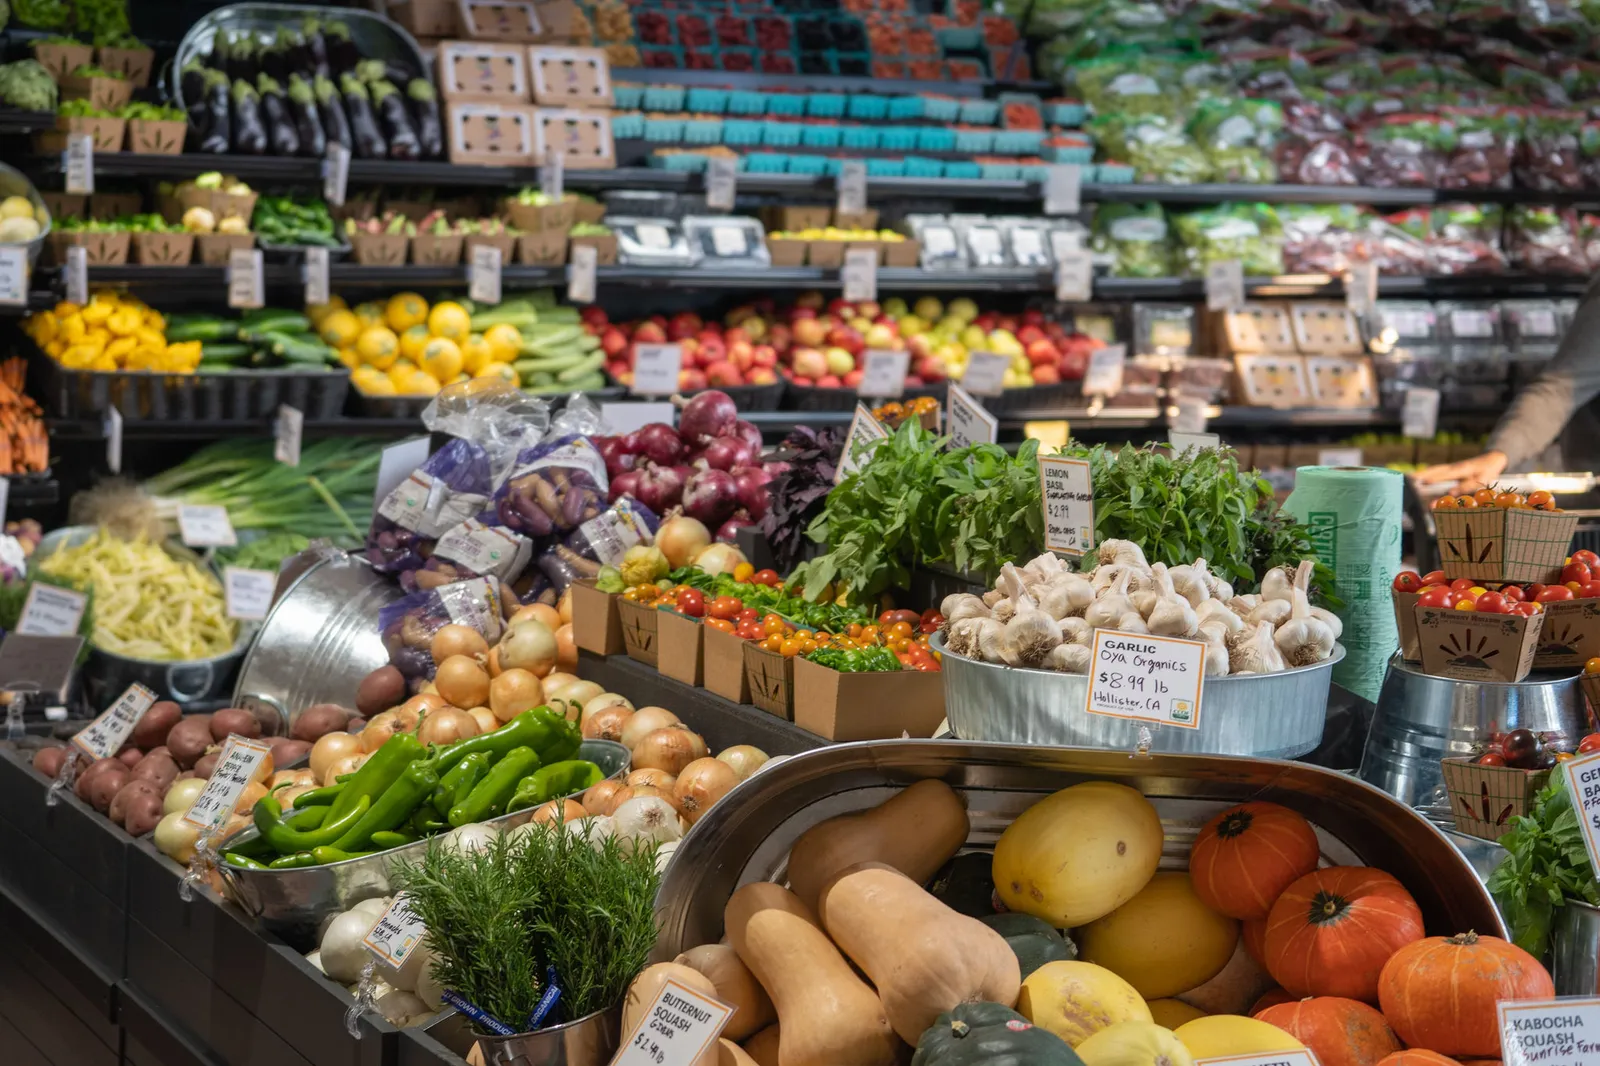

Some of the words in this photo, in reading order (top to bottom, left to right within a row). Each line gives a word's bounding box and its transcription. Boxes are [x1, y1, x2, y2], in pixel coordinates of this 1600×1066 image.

[1045, 468, 1069, 479] LEMON
[1046, 480, 1064, 490] BASIL
[1105, 640, 1156, 653] GARLIC
[1100, 649, 1127, 664] Oya
[1133, 655, 1187, 674] Organics
[1099, 671, 1145, 692] $8.99
[1155, 679, 1168, 693] lb
[1093, 691, 1143, 709] Hollister,
[1146, 698, 1160, 710] CA
[662, 992, 713, 1024] BUTTERNUT
[653, 1006, 693, 1032] SQUASH
[1513, 1015, 1584, 1031] KABOCHA
[1516, 1032, 1575, 1047] SQUASH
[1522, 1044, 1574, 1061] Sunrise
